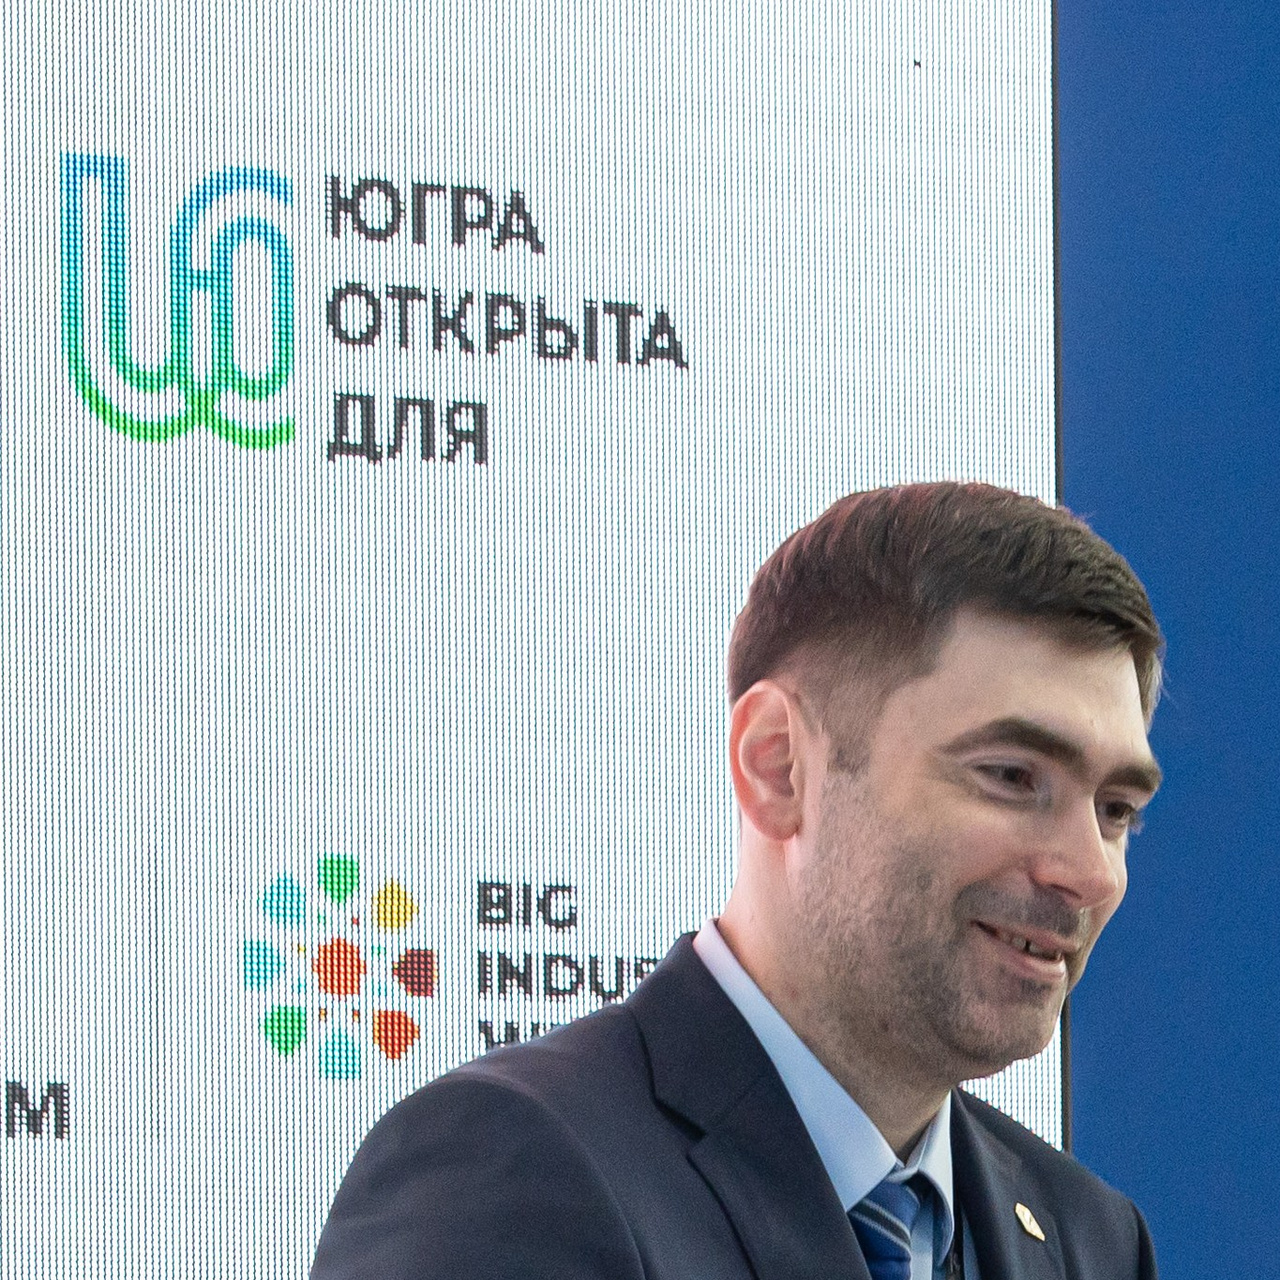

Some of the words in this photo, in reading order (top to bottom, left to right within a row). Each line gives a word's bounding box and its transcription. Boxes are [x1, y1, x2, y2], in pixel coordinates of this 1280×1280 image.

[326, 174, 546, 254] ЮГРА
[326, 281, 690, 370] ОТКРЫТА
[326, 392, 489, 464] ДЛЯ
[478, 882, 577, 929] BIG
